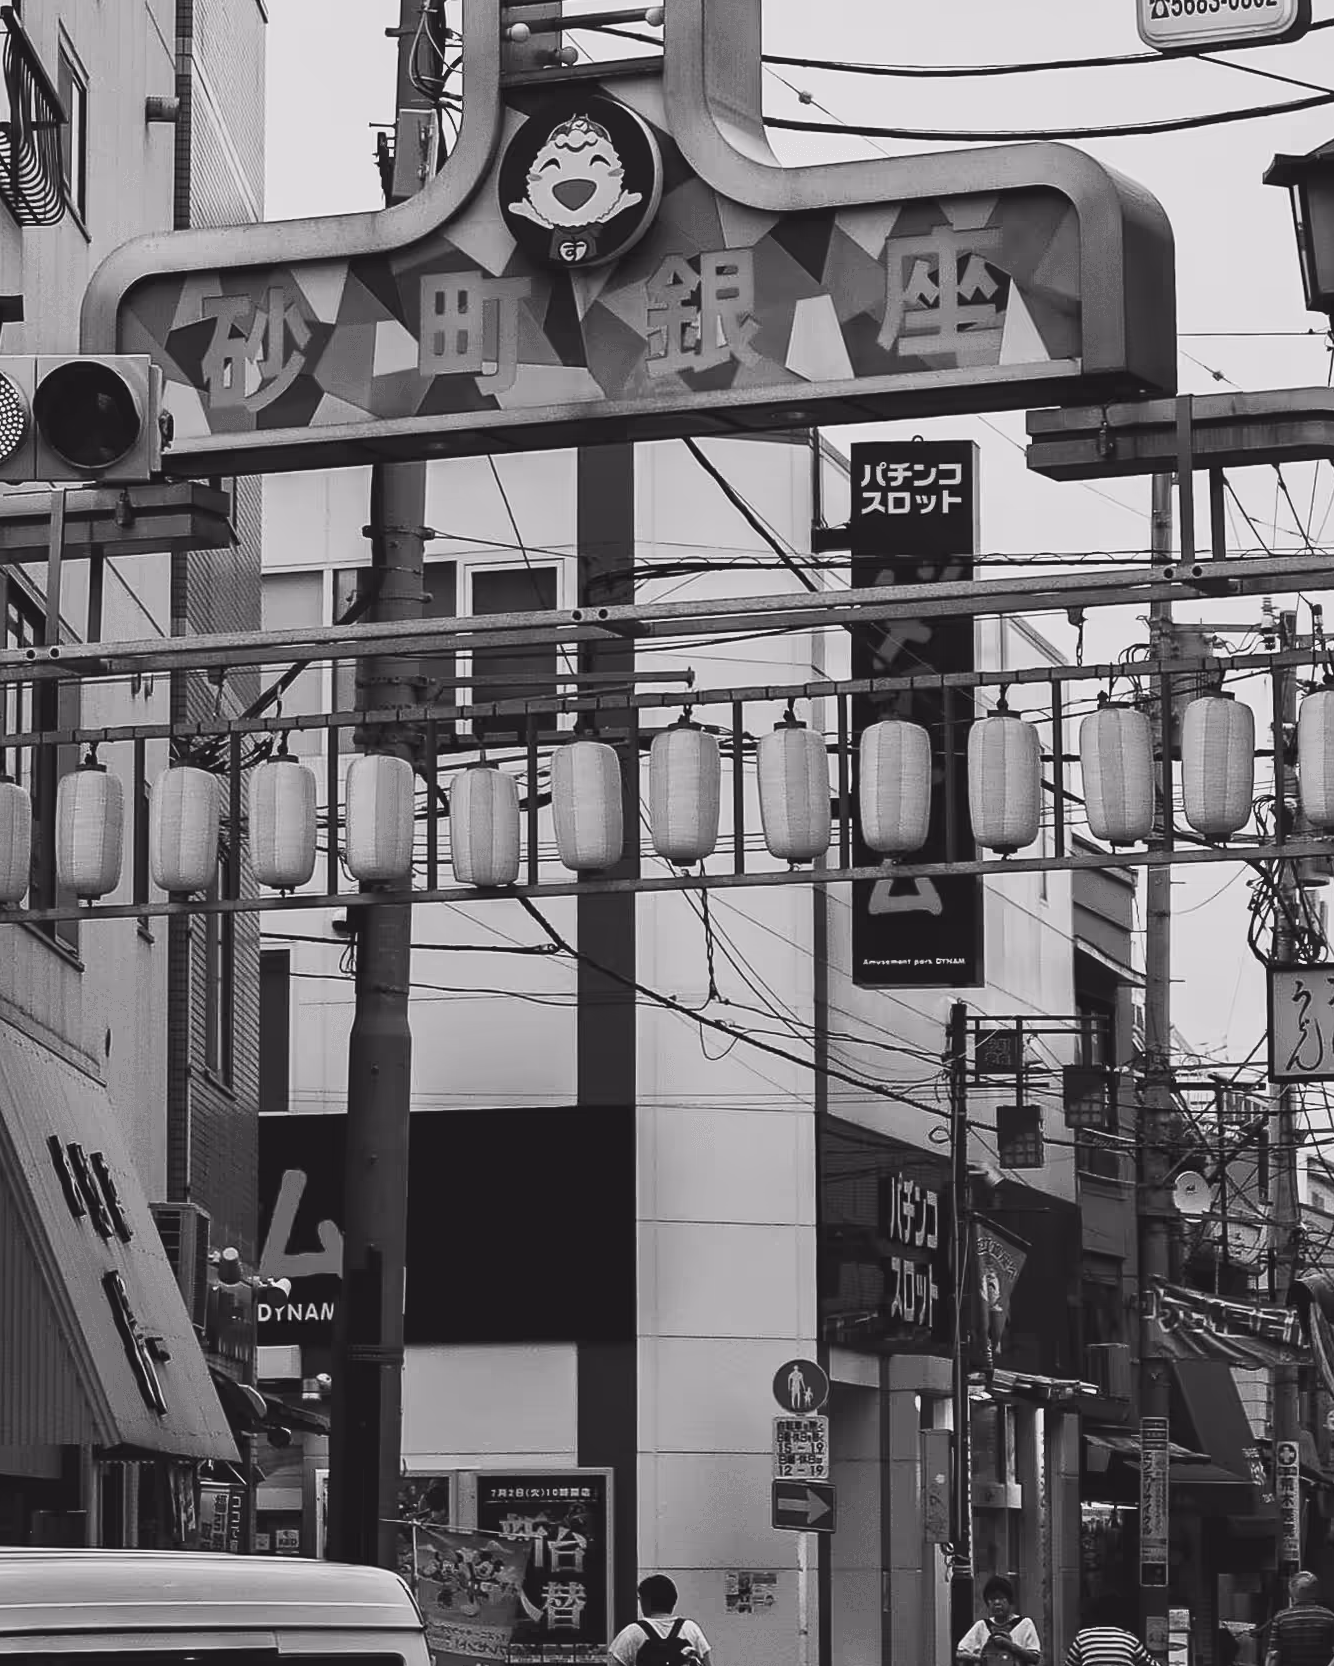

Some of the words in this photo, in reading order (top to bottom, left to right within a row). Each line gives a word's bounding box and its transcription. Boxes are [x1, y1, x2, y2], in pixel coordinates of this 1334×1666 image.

[199, 222, 1012, 415] 砂町銀座
[861, 461, 963, 488] パチンコ
[861, 491, 963, 515] スロット
[890, 1171, 938, 1249] パチンコ
[890, 1255, 939, 1329] スロット
